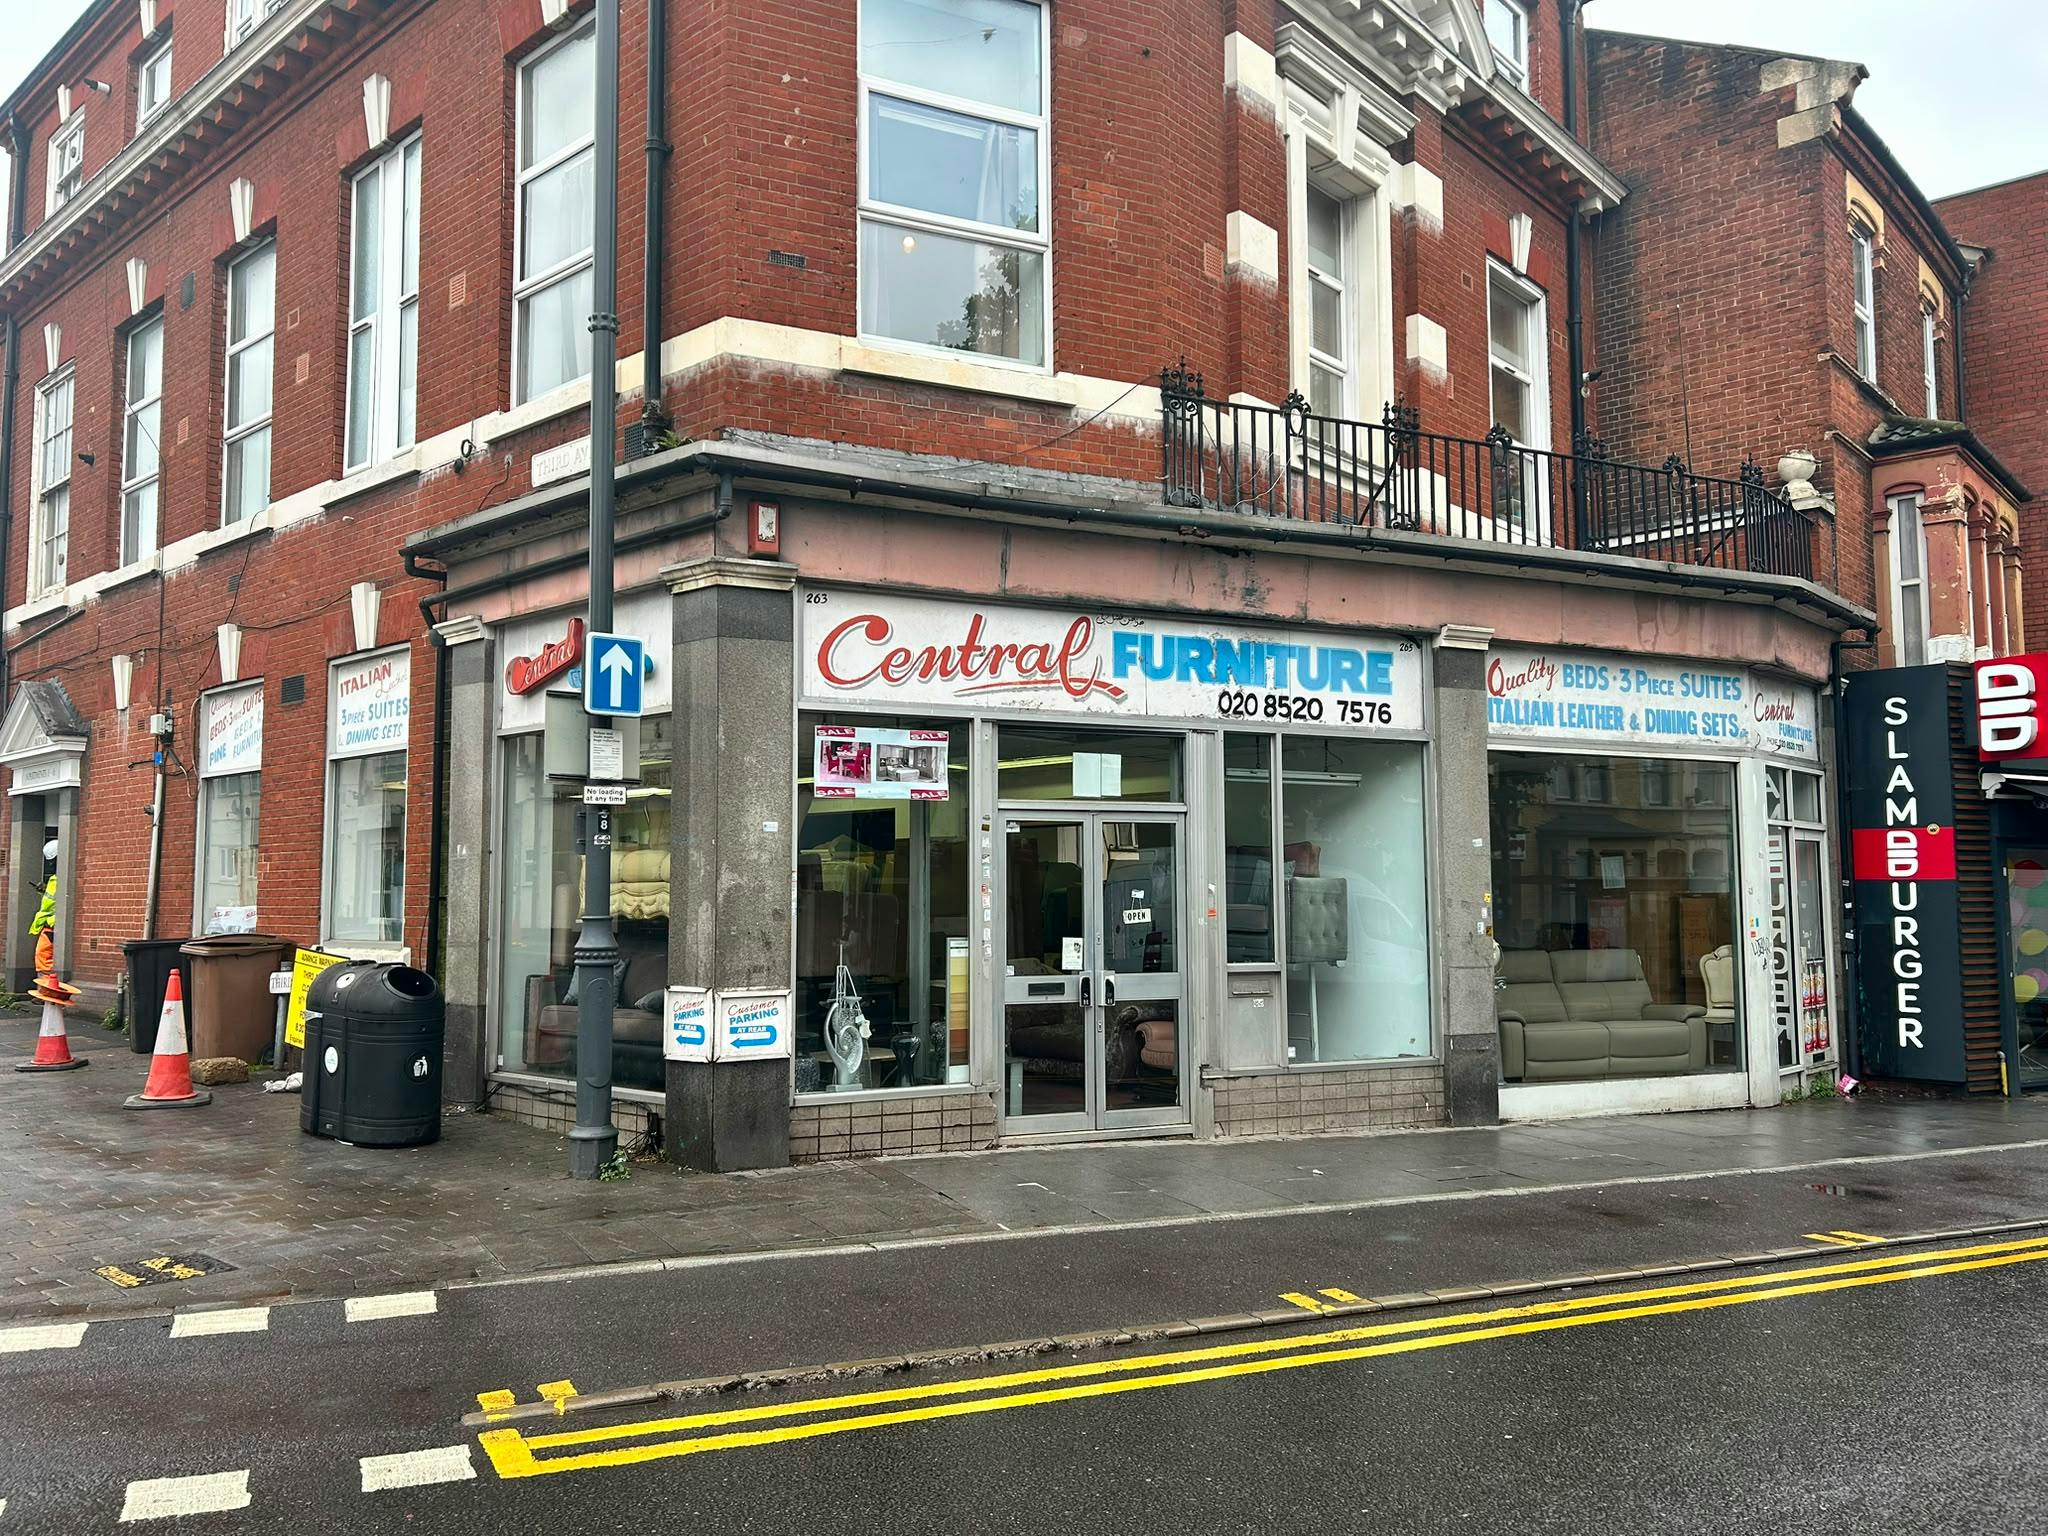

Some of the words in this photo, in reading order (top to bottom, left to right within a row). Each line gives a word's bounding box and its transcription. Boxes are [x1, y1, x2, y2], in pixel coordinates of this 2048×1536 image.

[537, 451, 570, 476] THIRD
[806, 592, 828, 604] 263
[505, 619, 579, 694] Central
[817, 613, 1102, 697] Central
[1112, 630, 1394, 695] FURNITURE
[1400, 643, 1414, 653] 265
[340, 662, 392, 697] ITALIAN
[1487, 656, 1559, 697] Quality
[1563, 664, 1609, 691] BEDS
[1619, 668, 1632, 693] 3
[1680, 672, 1743, 701] SUITES
[341, 709, 347, 726] 3
[368, 697, 408, 721] SUITES
[1218, 691, 1258, 716] 020
[1264, 694, 1323, 721] 8520
[1337, 700, 1392, 724] 7576
[1488, 697, 1554, 727] ITALIAN
[1558, 703, 1624, 731] LEATHER
[1630, 713, 1640, 730] &
[1645, 708, 1697, 735] DINING
[1701, 711, 1739, 738] SETS
[1754, 691, 1795, 722] Central
[209, 716, 227, 741] BEDS
[346, 726, 379, 745] DINING
[381, 723, 403, 740] SETS
[817, 727, 855, 737] SALE
[910, 732, 948, 741] SALE
[1778, 722, 1812, 742] FURNITURE
[209, 743, 226, 767] PINE
[599, 788, 624, 796] loading
[817, 788, 855, 798] SALE
[910, 790, 948, 800] SALE
[1127, 911, 1146, 921] OPEN
[673, 1000, 704, 1012] Customer
[674, 1007, 705, 1021] PARKING
[728, 1000, 777, 1016] Customer
[729, 1007, 779, 1025] PARKING
